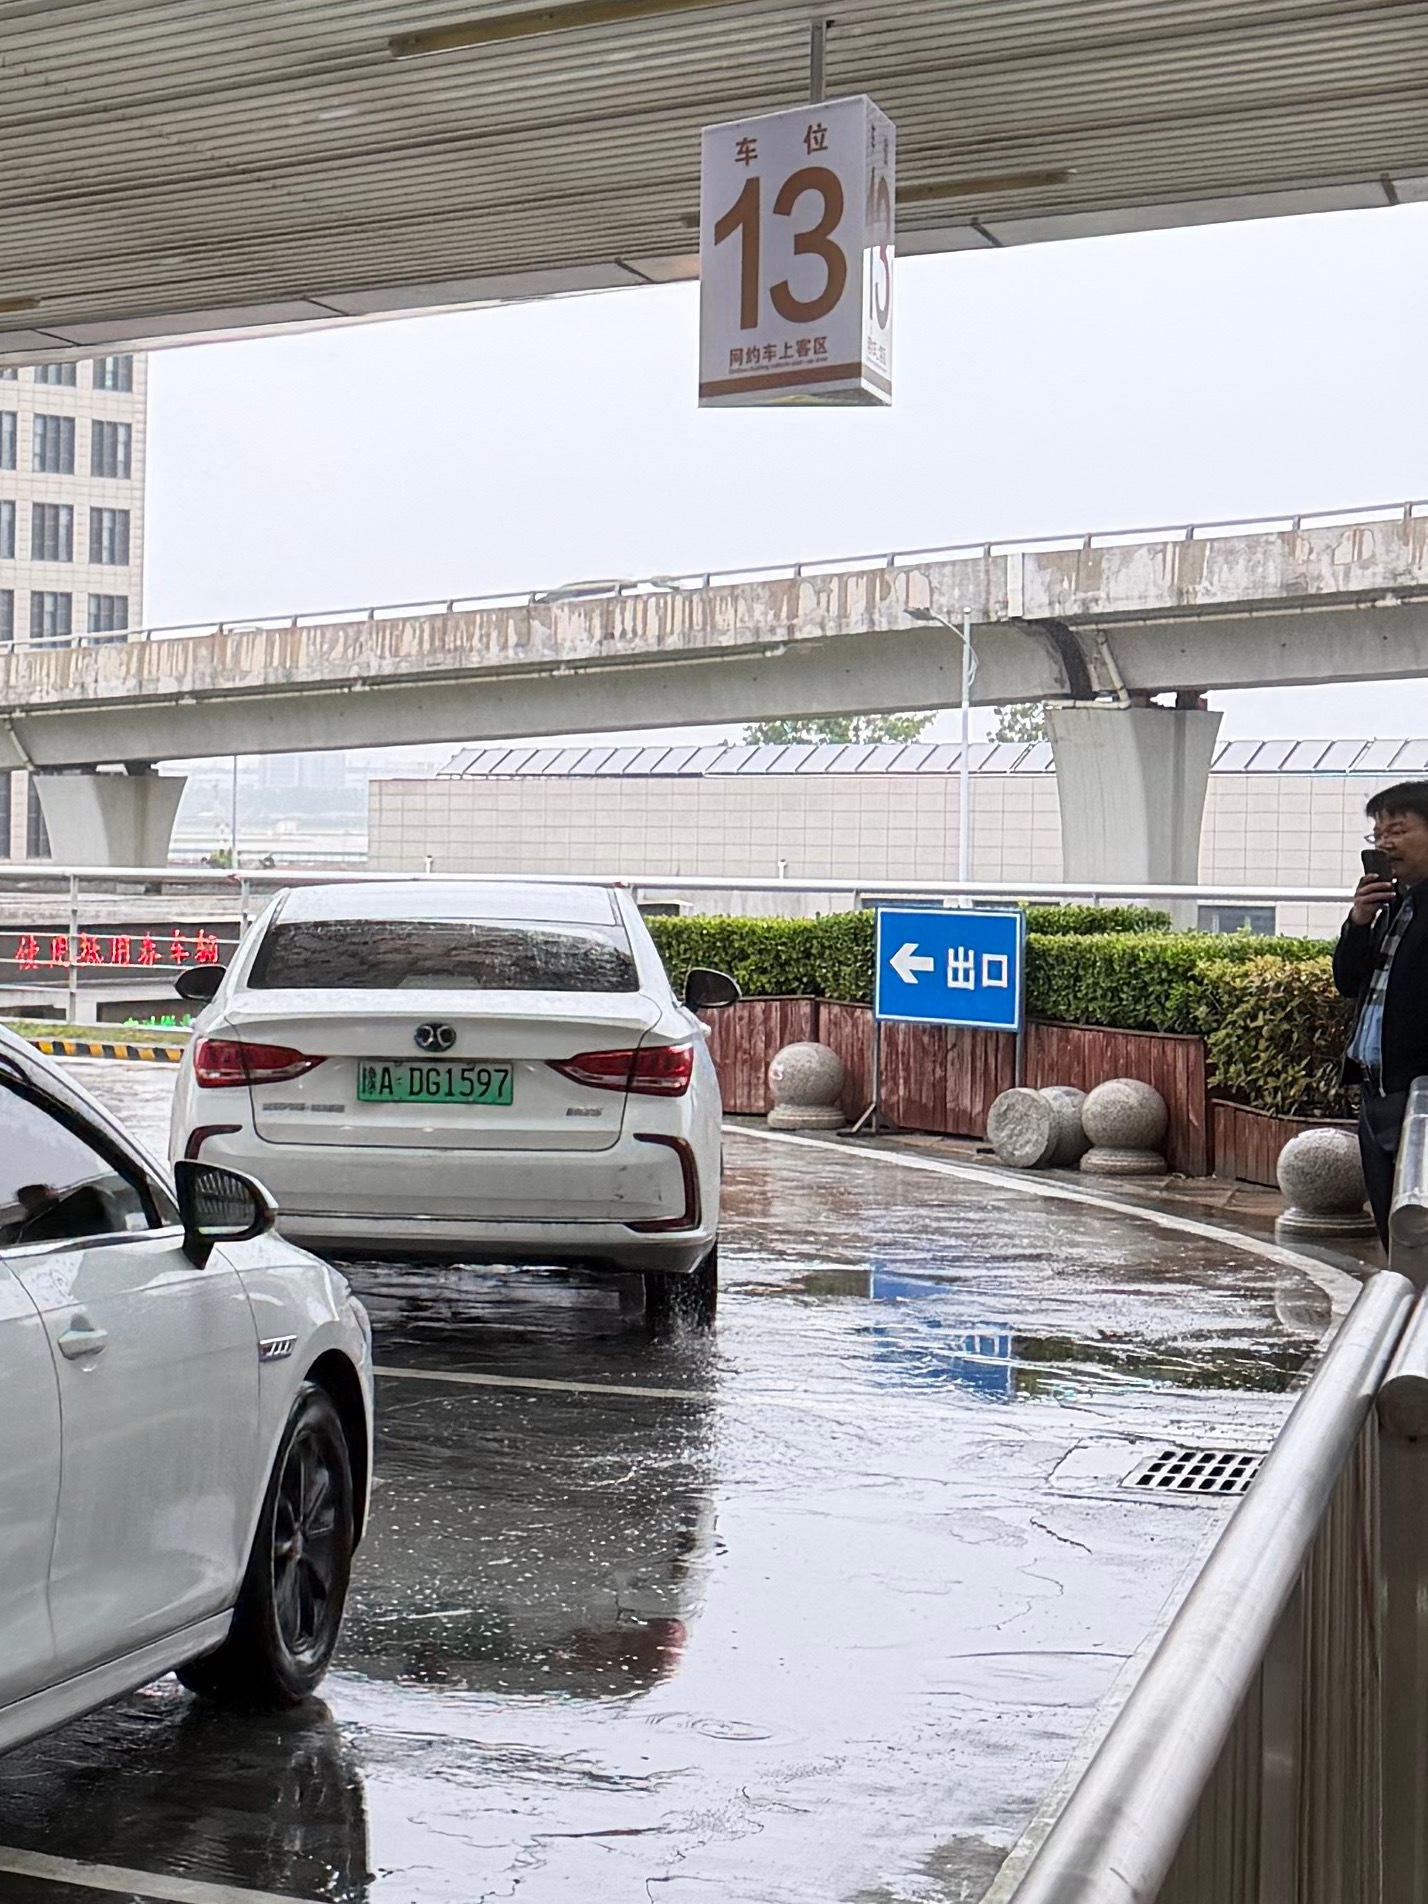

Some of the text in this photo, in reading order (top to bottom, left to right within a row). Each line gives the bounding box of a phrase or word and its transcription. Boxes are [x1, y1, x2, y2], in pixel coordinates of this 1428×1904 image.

[735, 124, 829, 166] 车位
[714, 166, 847, 330] 13
[730, 336, 827, 367] 网约车上客区
[947, 946, 1008, 990] 出口
